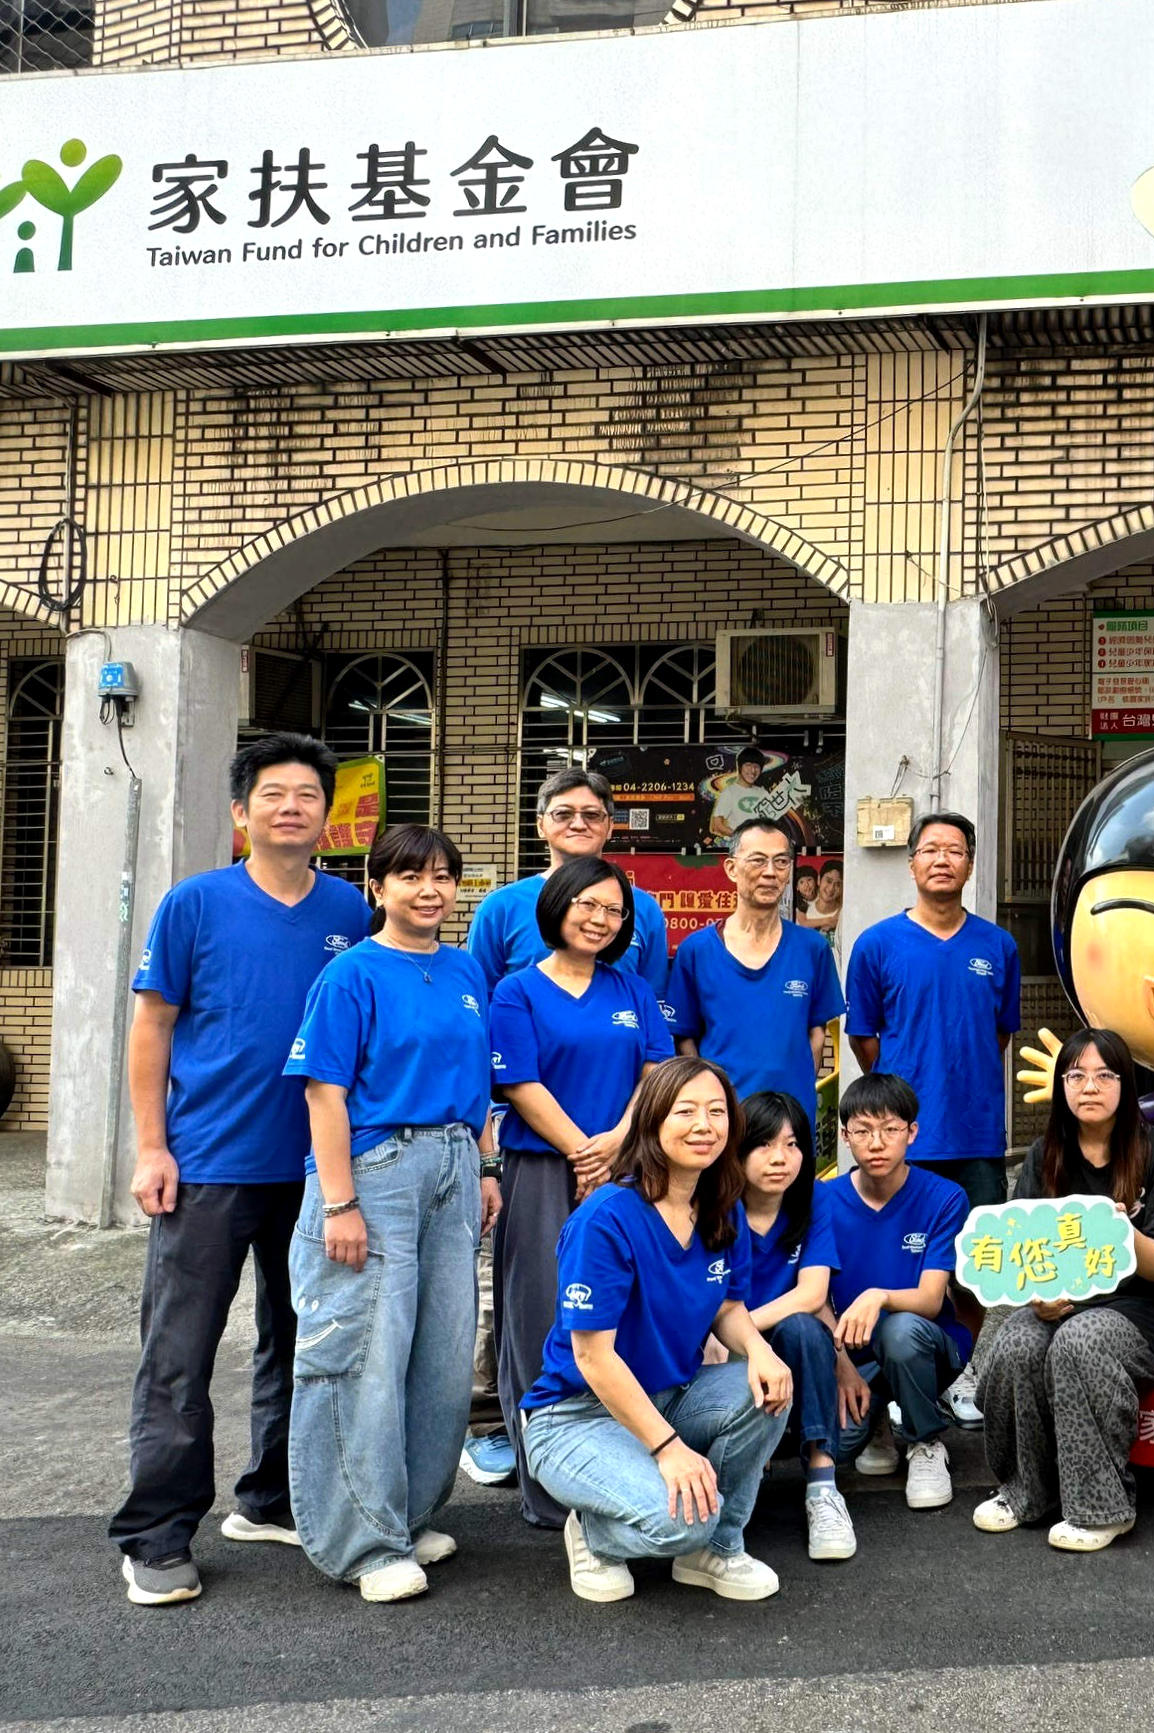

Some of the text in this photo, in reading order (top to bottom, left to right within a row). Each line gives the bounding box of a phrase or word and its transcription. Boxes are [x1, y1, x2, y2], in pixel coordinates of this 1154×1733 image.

[146, 126, 640, 234] 家扶基金會
[147, 220, 637, 267] Taiwan Fund for Children and Families
[623, 782, 695, 792] 04-2206-1234
[971, 1213, 1117, 1291] 有您真好
